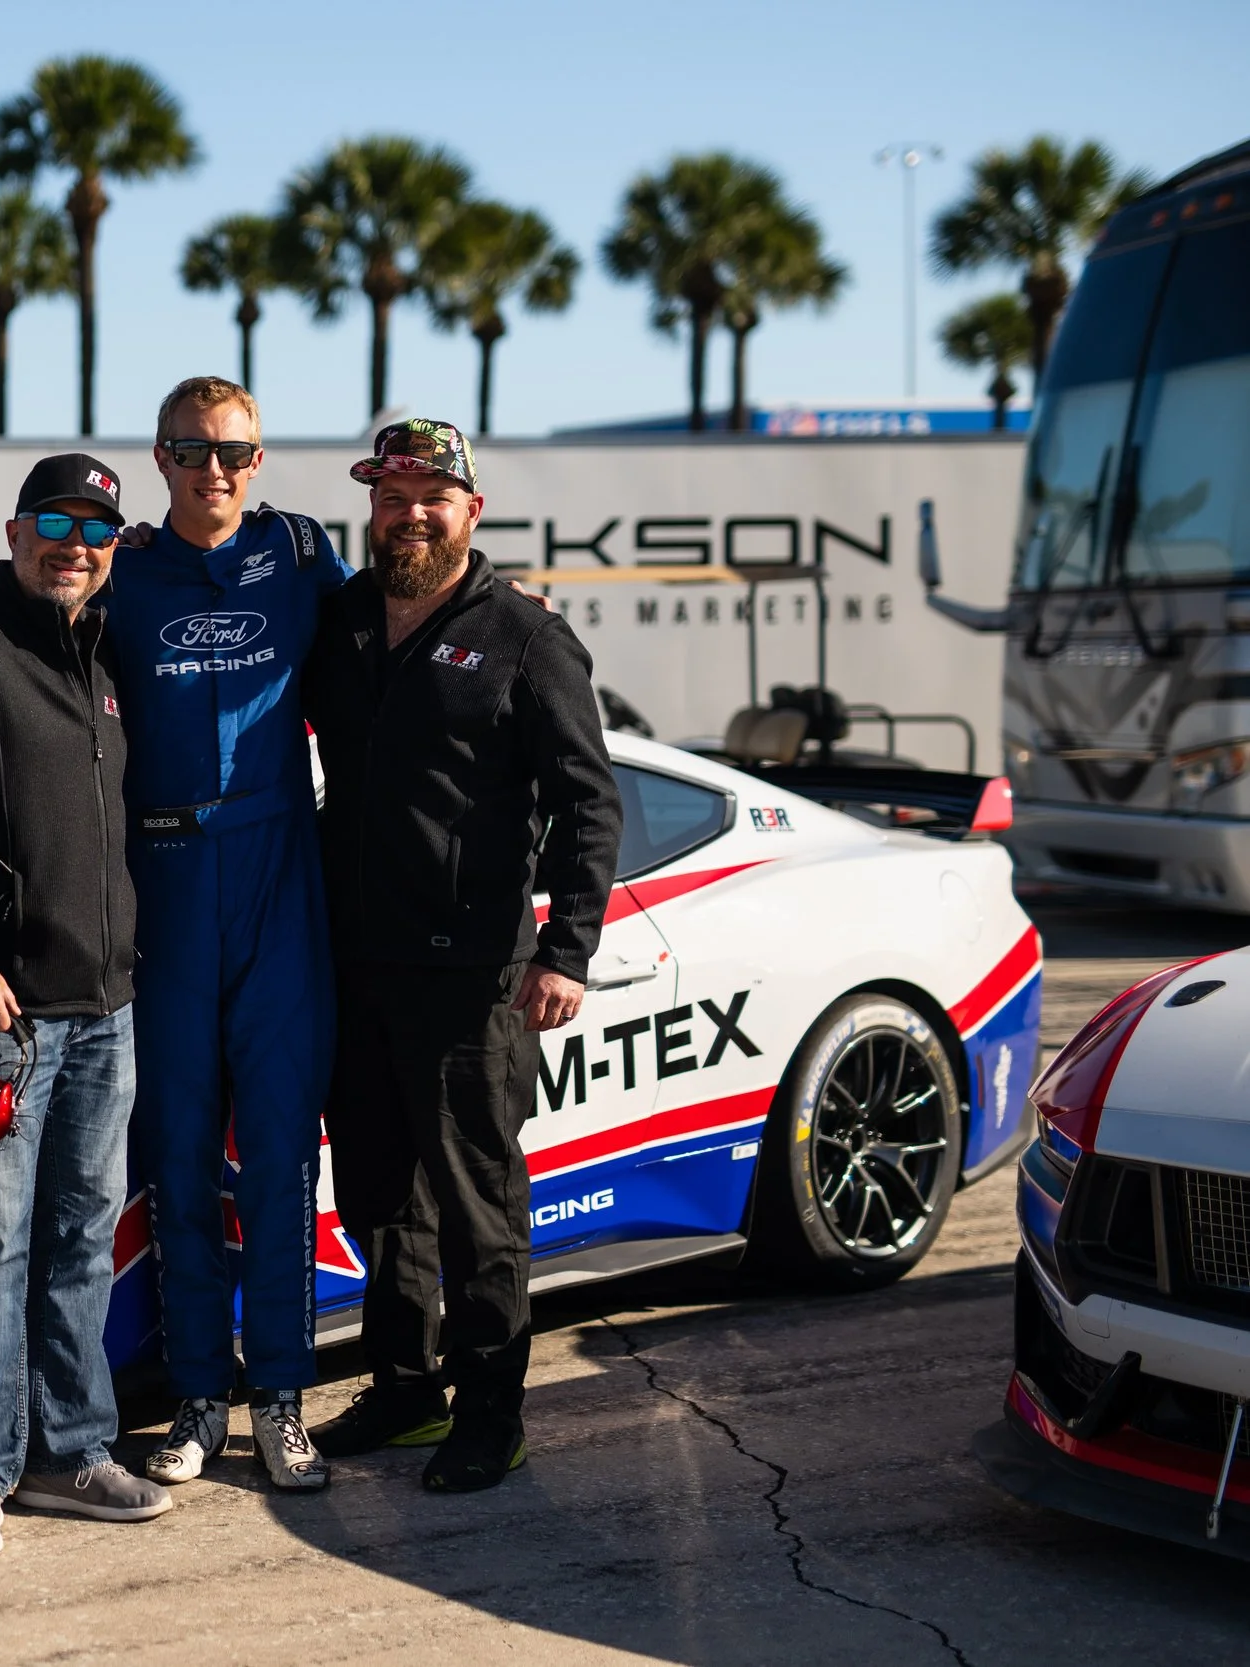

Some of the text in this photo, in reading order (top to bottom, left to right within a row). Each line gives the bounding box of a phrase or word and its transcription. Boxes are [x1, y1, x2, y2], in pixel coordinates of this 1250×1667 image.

[87, 470, 118, 496] R3R
[637, 593, 893, 628] MARKETNG
[181, 617, 247, 646] Ford
[155, 647, 275, 676] RACING
[434, 643, 485, 667] R3R
[143, 817, 181, 828] sparco
[749, 807, 791, 826] R3R
[526, 989, 764, 1119] M-TEX
[301, 1161, 312, 1268] RACING
[529, 1188, 615, 1229] CING
[279, 1391, 296, 1400] OMP
